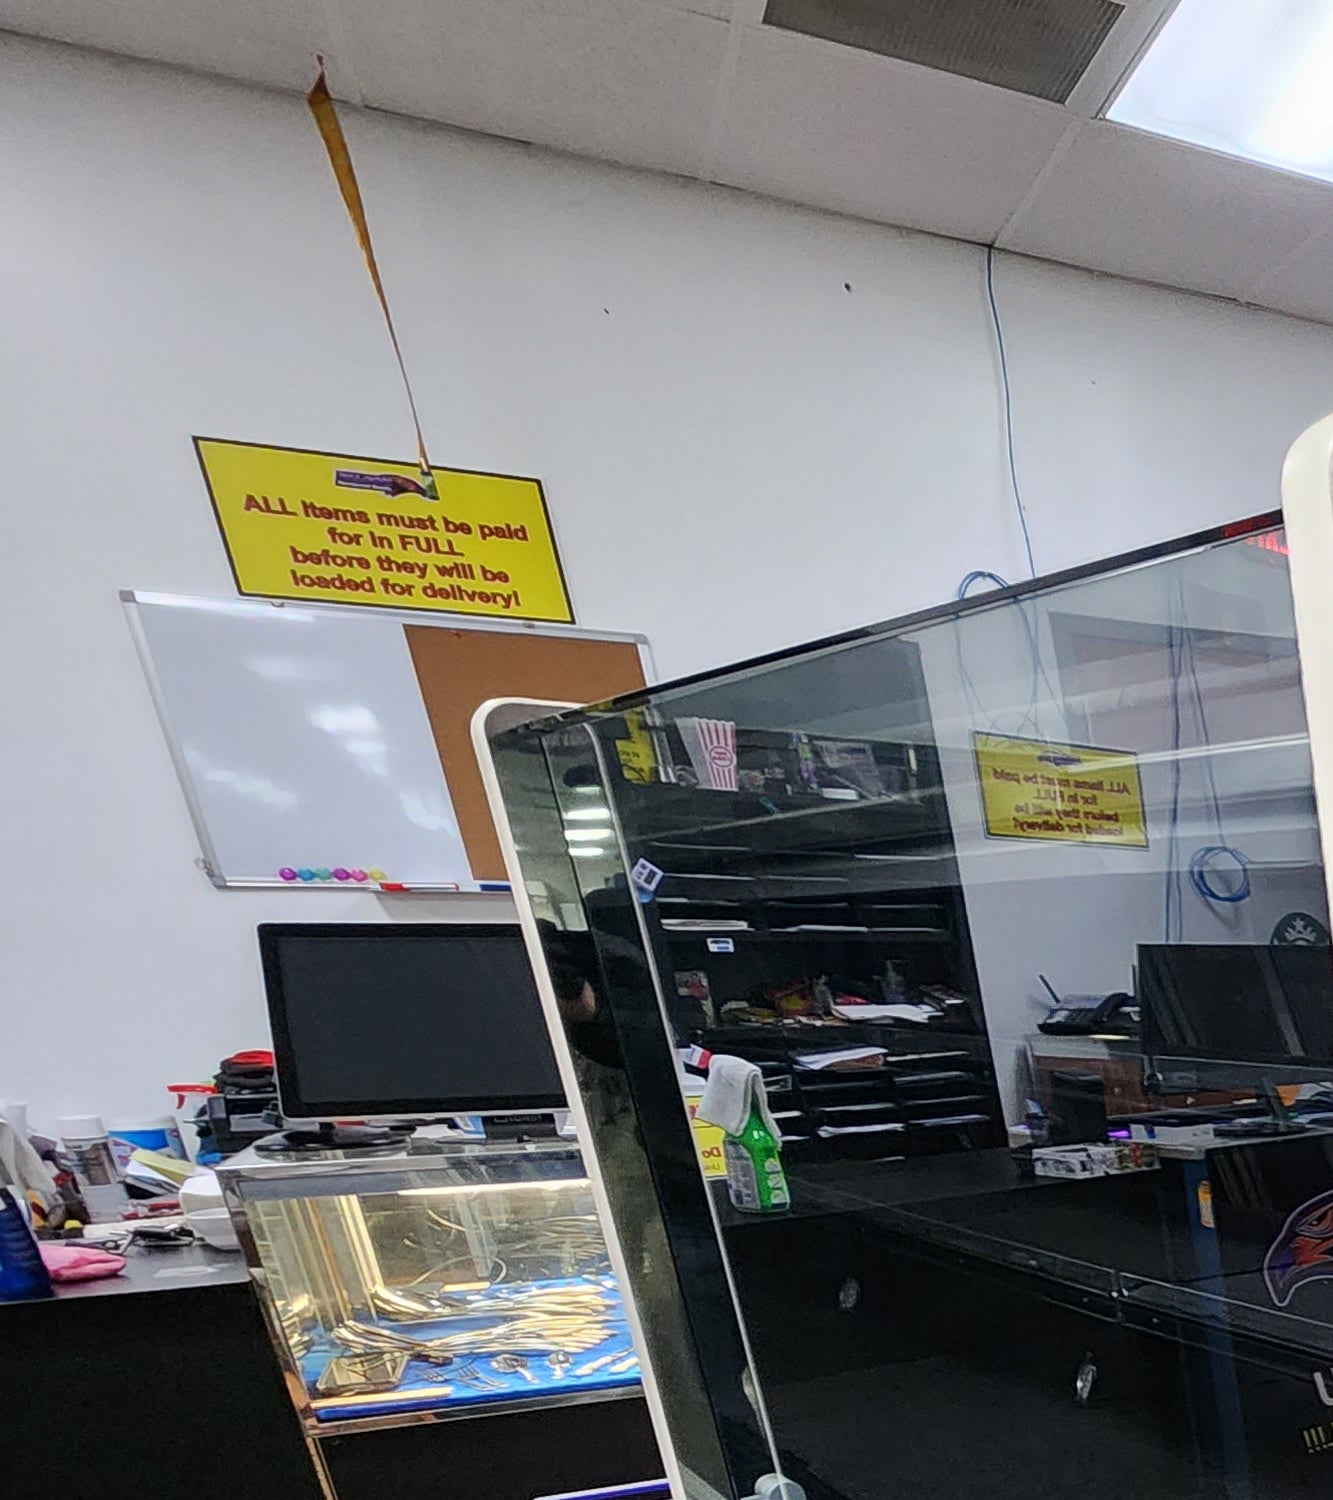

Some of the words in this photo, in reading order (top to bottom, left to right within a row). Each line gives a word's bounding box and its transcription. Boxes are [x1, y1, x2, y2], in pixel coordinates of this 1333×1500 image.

[244, 494, 298, 517] ALL
[376, 512, 439, 532] must
[441, 515, 472, 535] be
[478, 522, 529, 541] paid
[327, 527, 363, 545] for
[398, 534, 465, 557] FULL
[290, 545, 371, 570] before
[376, 555, 428, 579] they
[433, 562, 475, 580] will
[480, 564, 509, 583] be
[290, 569, 375, 593] loaded
[380, 577, 415, 597] for
[422, 582, 521, 609] delivery!
